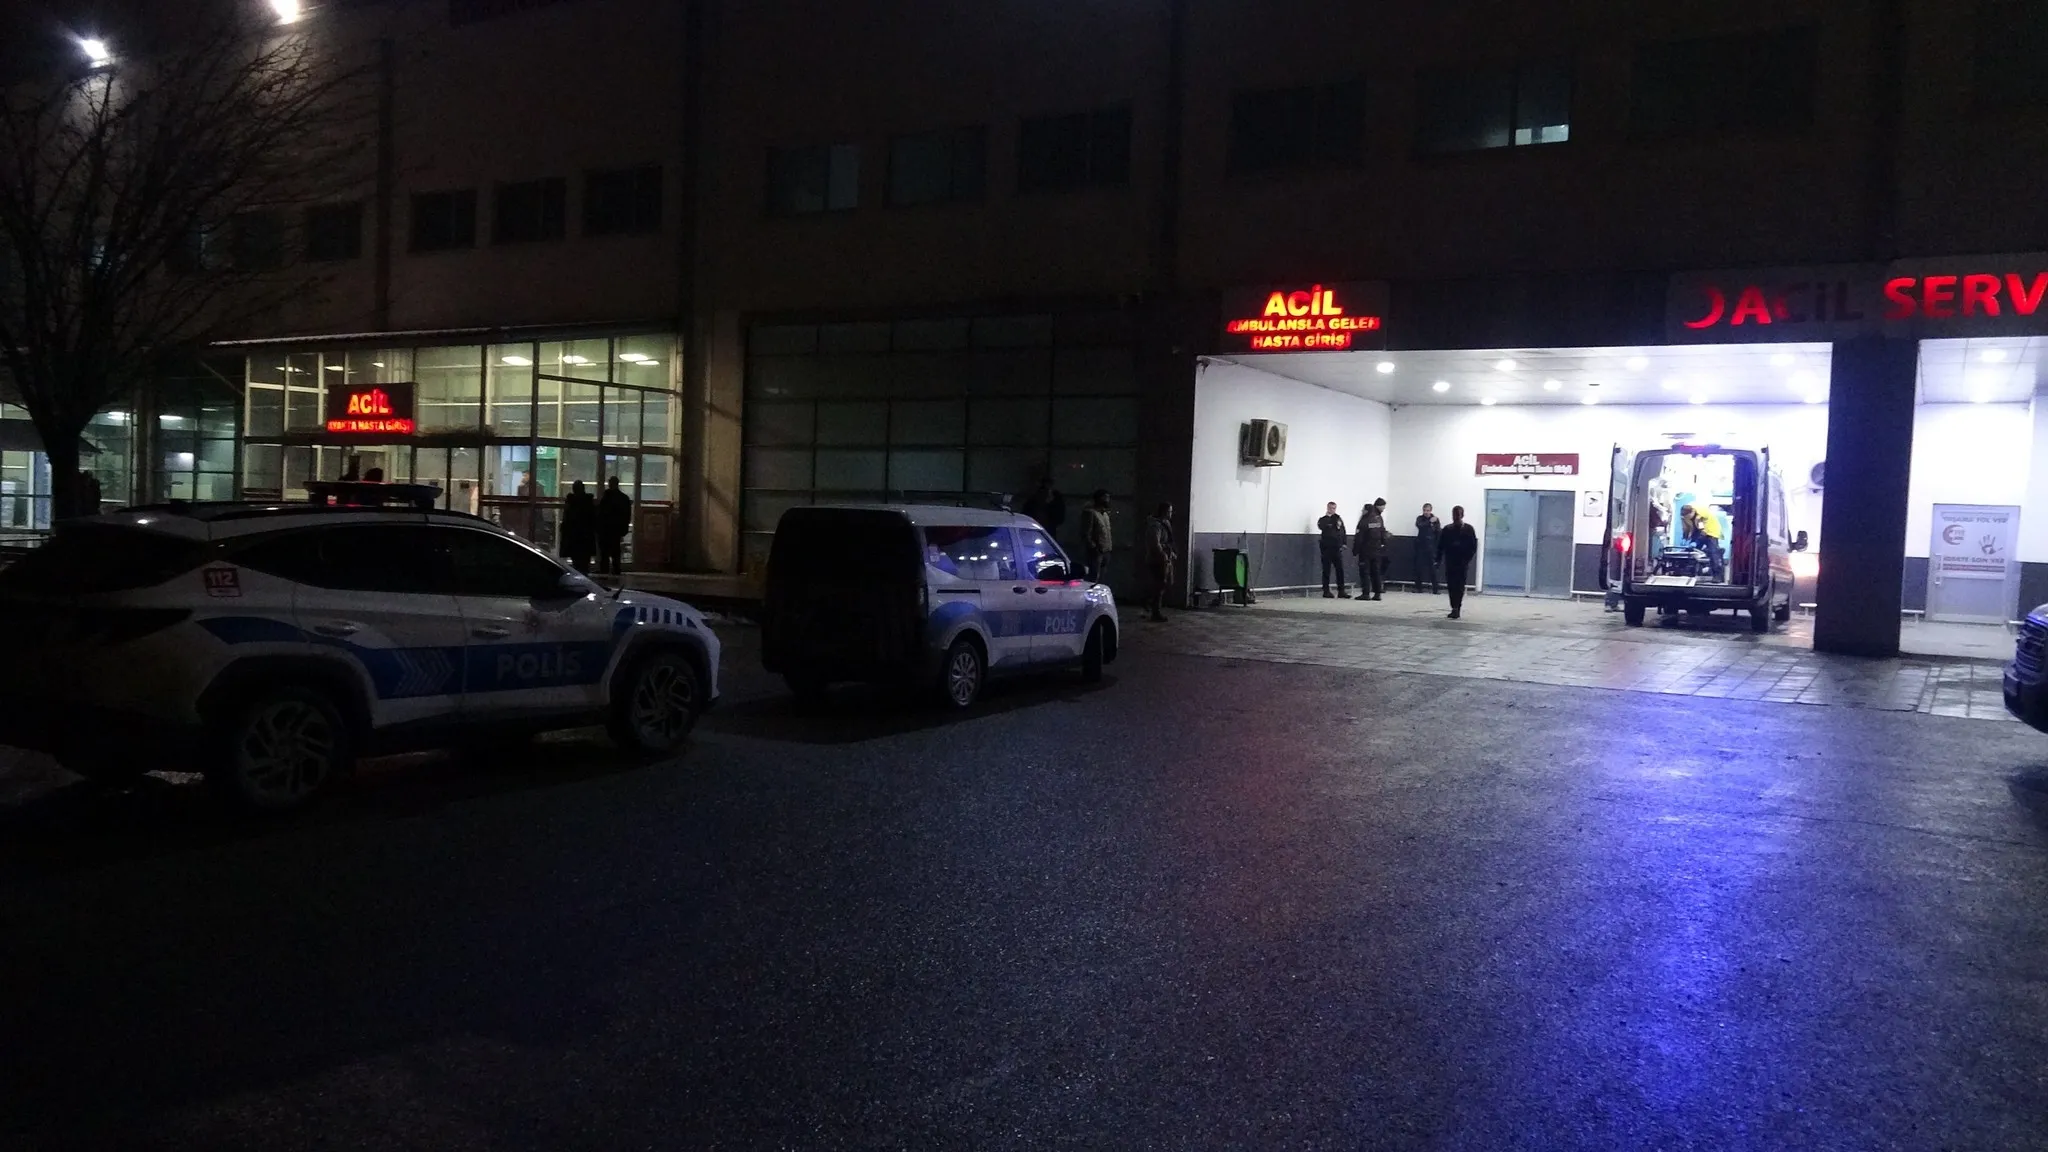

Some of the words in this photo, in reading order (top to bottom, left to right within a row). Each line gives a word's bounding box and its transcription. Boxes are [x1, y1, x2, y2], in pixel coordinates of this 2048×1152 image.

[1264, 285, 1342, 316] ACİL
[1227, 319, 1325, 332] AMBULANSLA
[1252, 335, 1300, 348] HASTA
[347, 389, 391, 414] ACİL
[1513, 454, 1540, 465] ACİL
[208, 571, 234, 586] 112
[496, 644, 584, 681] POLİS
